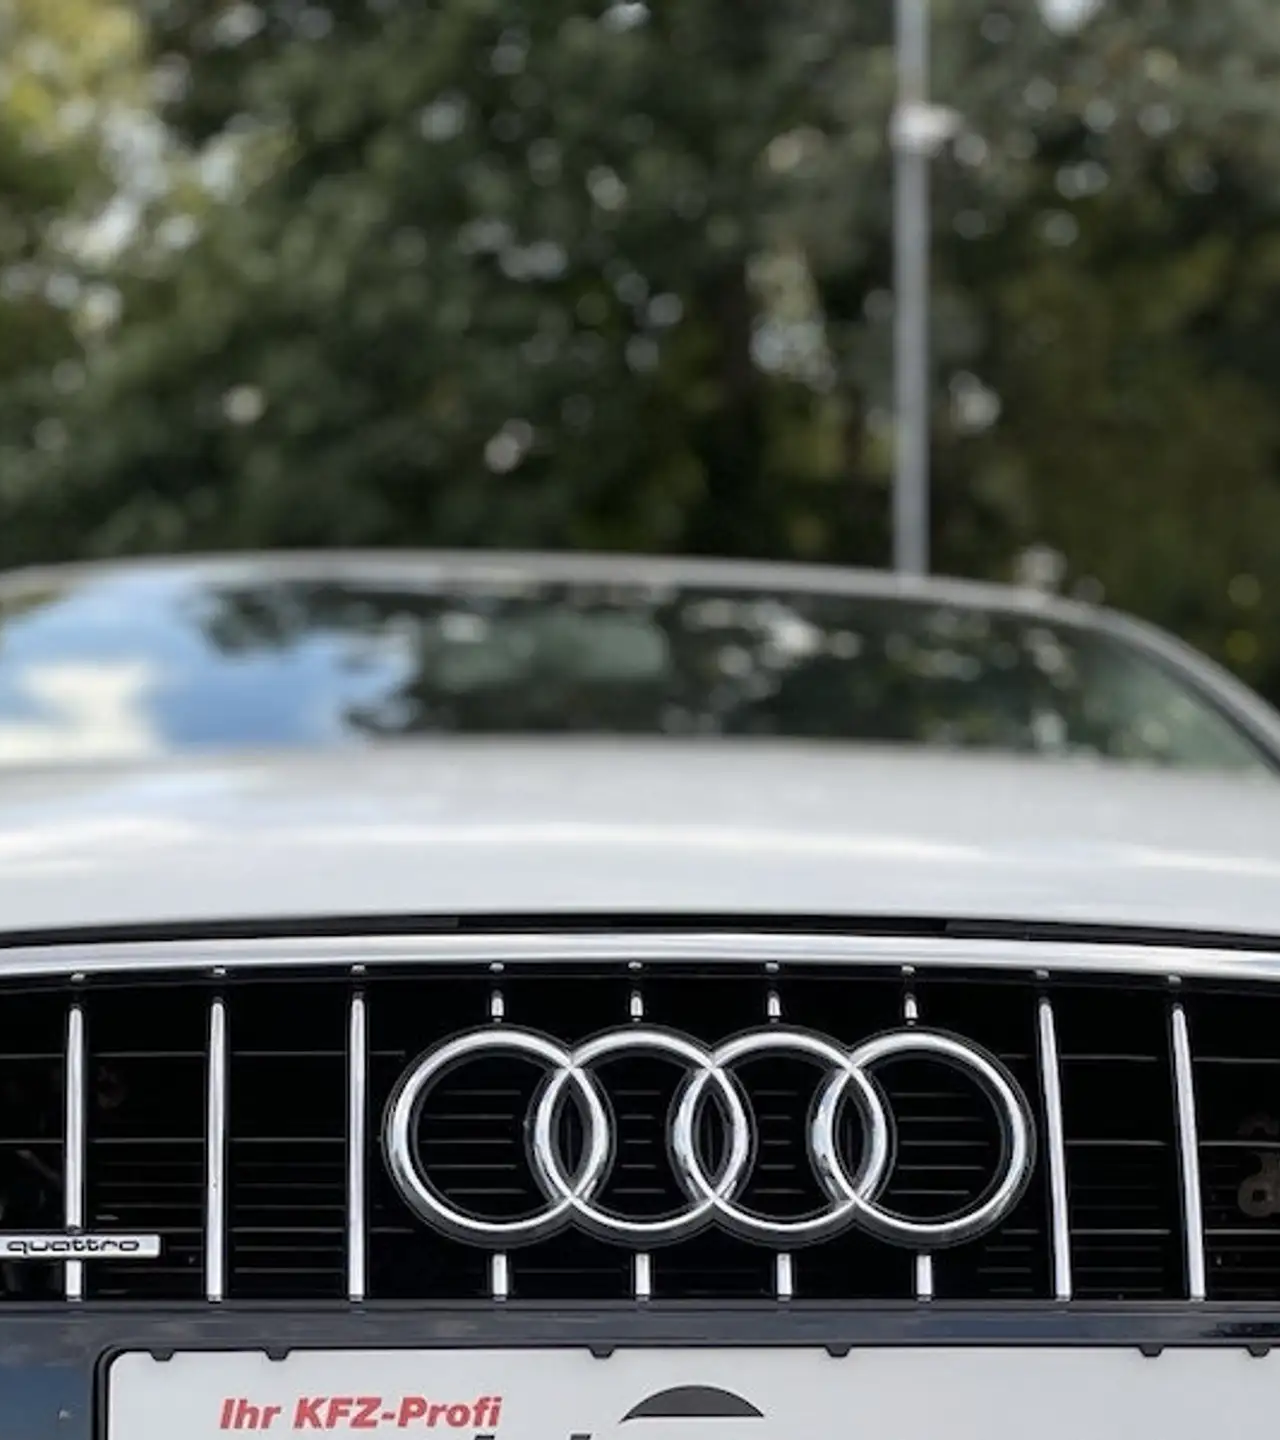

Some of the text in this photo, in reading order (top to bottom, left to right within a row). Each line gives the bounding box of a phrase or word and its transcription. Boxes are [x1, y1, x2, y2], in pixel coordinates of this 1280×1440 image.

[6, 1238, 140, 1256] quattro
[220, 1396, 501, 1428] Ihr KFZ-Profi
